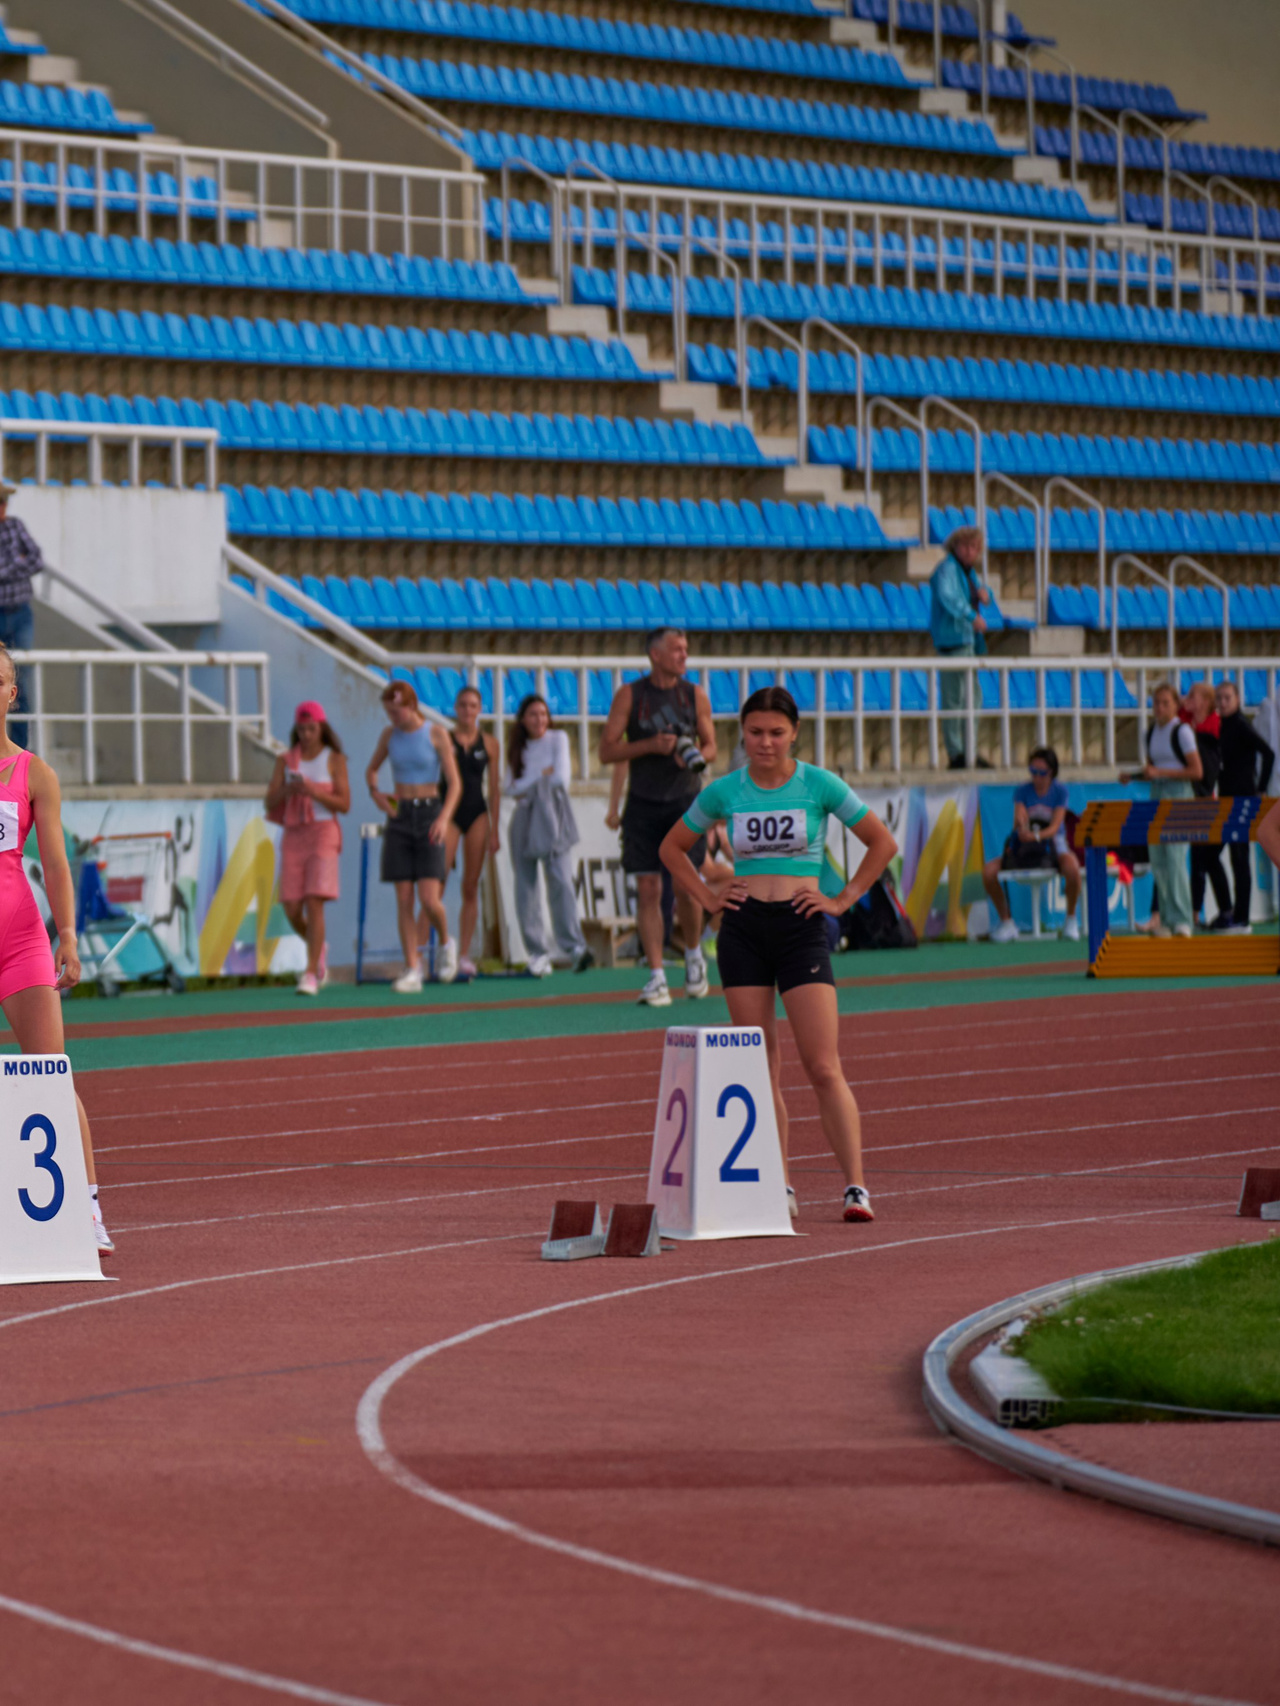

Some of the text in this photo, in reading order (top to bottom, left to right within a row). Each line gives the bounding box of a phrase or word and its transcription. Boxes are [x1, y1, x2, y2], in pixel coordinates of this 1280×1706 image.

[747, 816, 794, 842] 902
[666, 1032, 697, 1048] MONDO
[706, 1032, 761, 1048] MONDO
[4, 1059, 68, 1076] MONDO
[661, 1087, 688, 1187] 2
[716, 1083, 760, 1182] 2
[17, 1113, 65, 1222] 3
